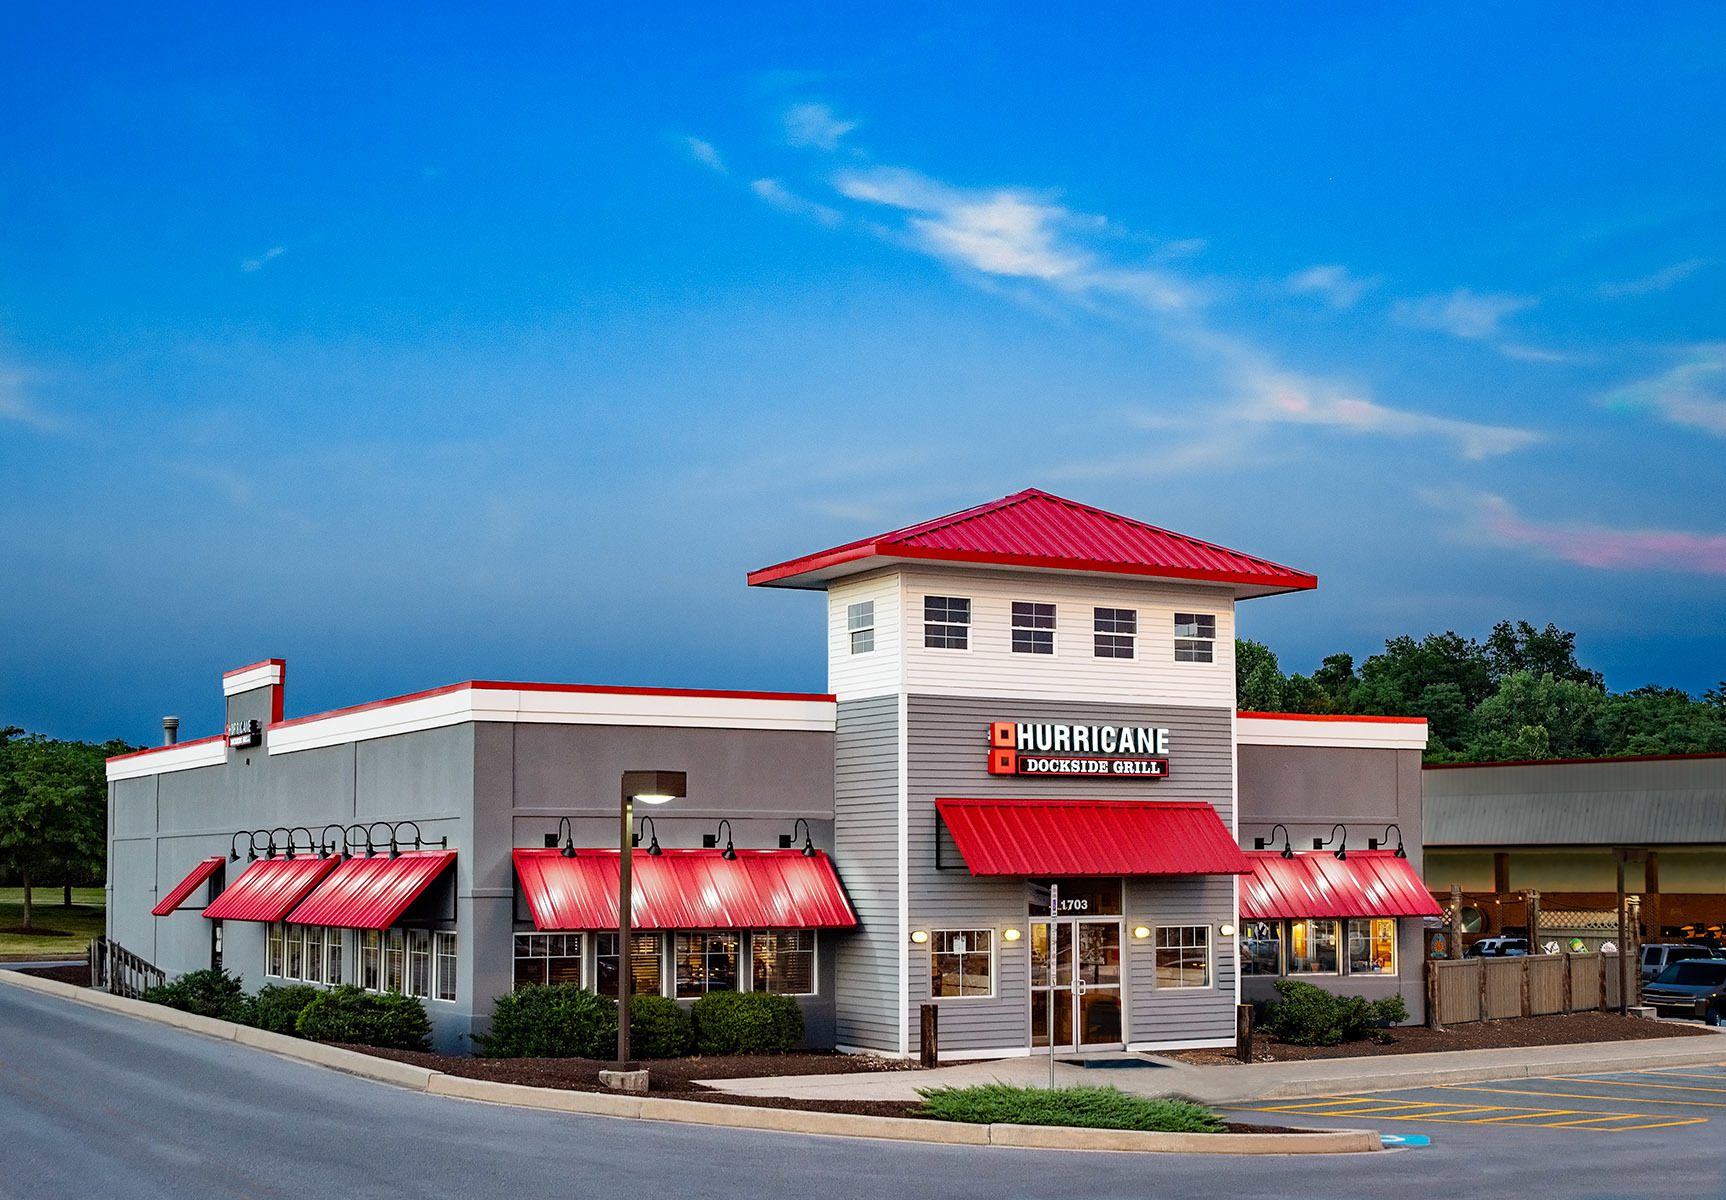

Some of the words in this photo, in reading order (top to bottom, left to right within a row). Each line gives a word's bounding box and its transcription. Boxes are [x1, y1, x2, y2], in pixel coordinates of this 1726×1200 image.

[1017, 723, 1169, 754] HURRICANE
[1027, 759, 1108, 773] DOCKSIDE
[1113, 760, 1160, 774] GRILL
[1060, 899, 1088, 910] 1703
